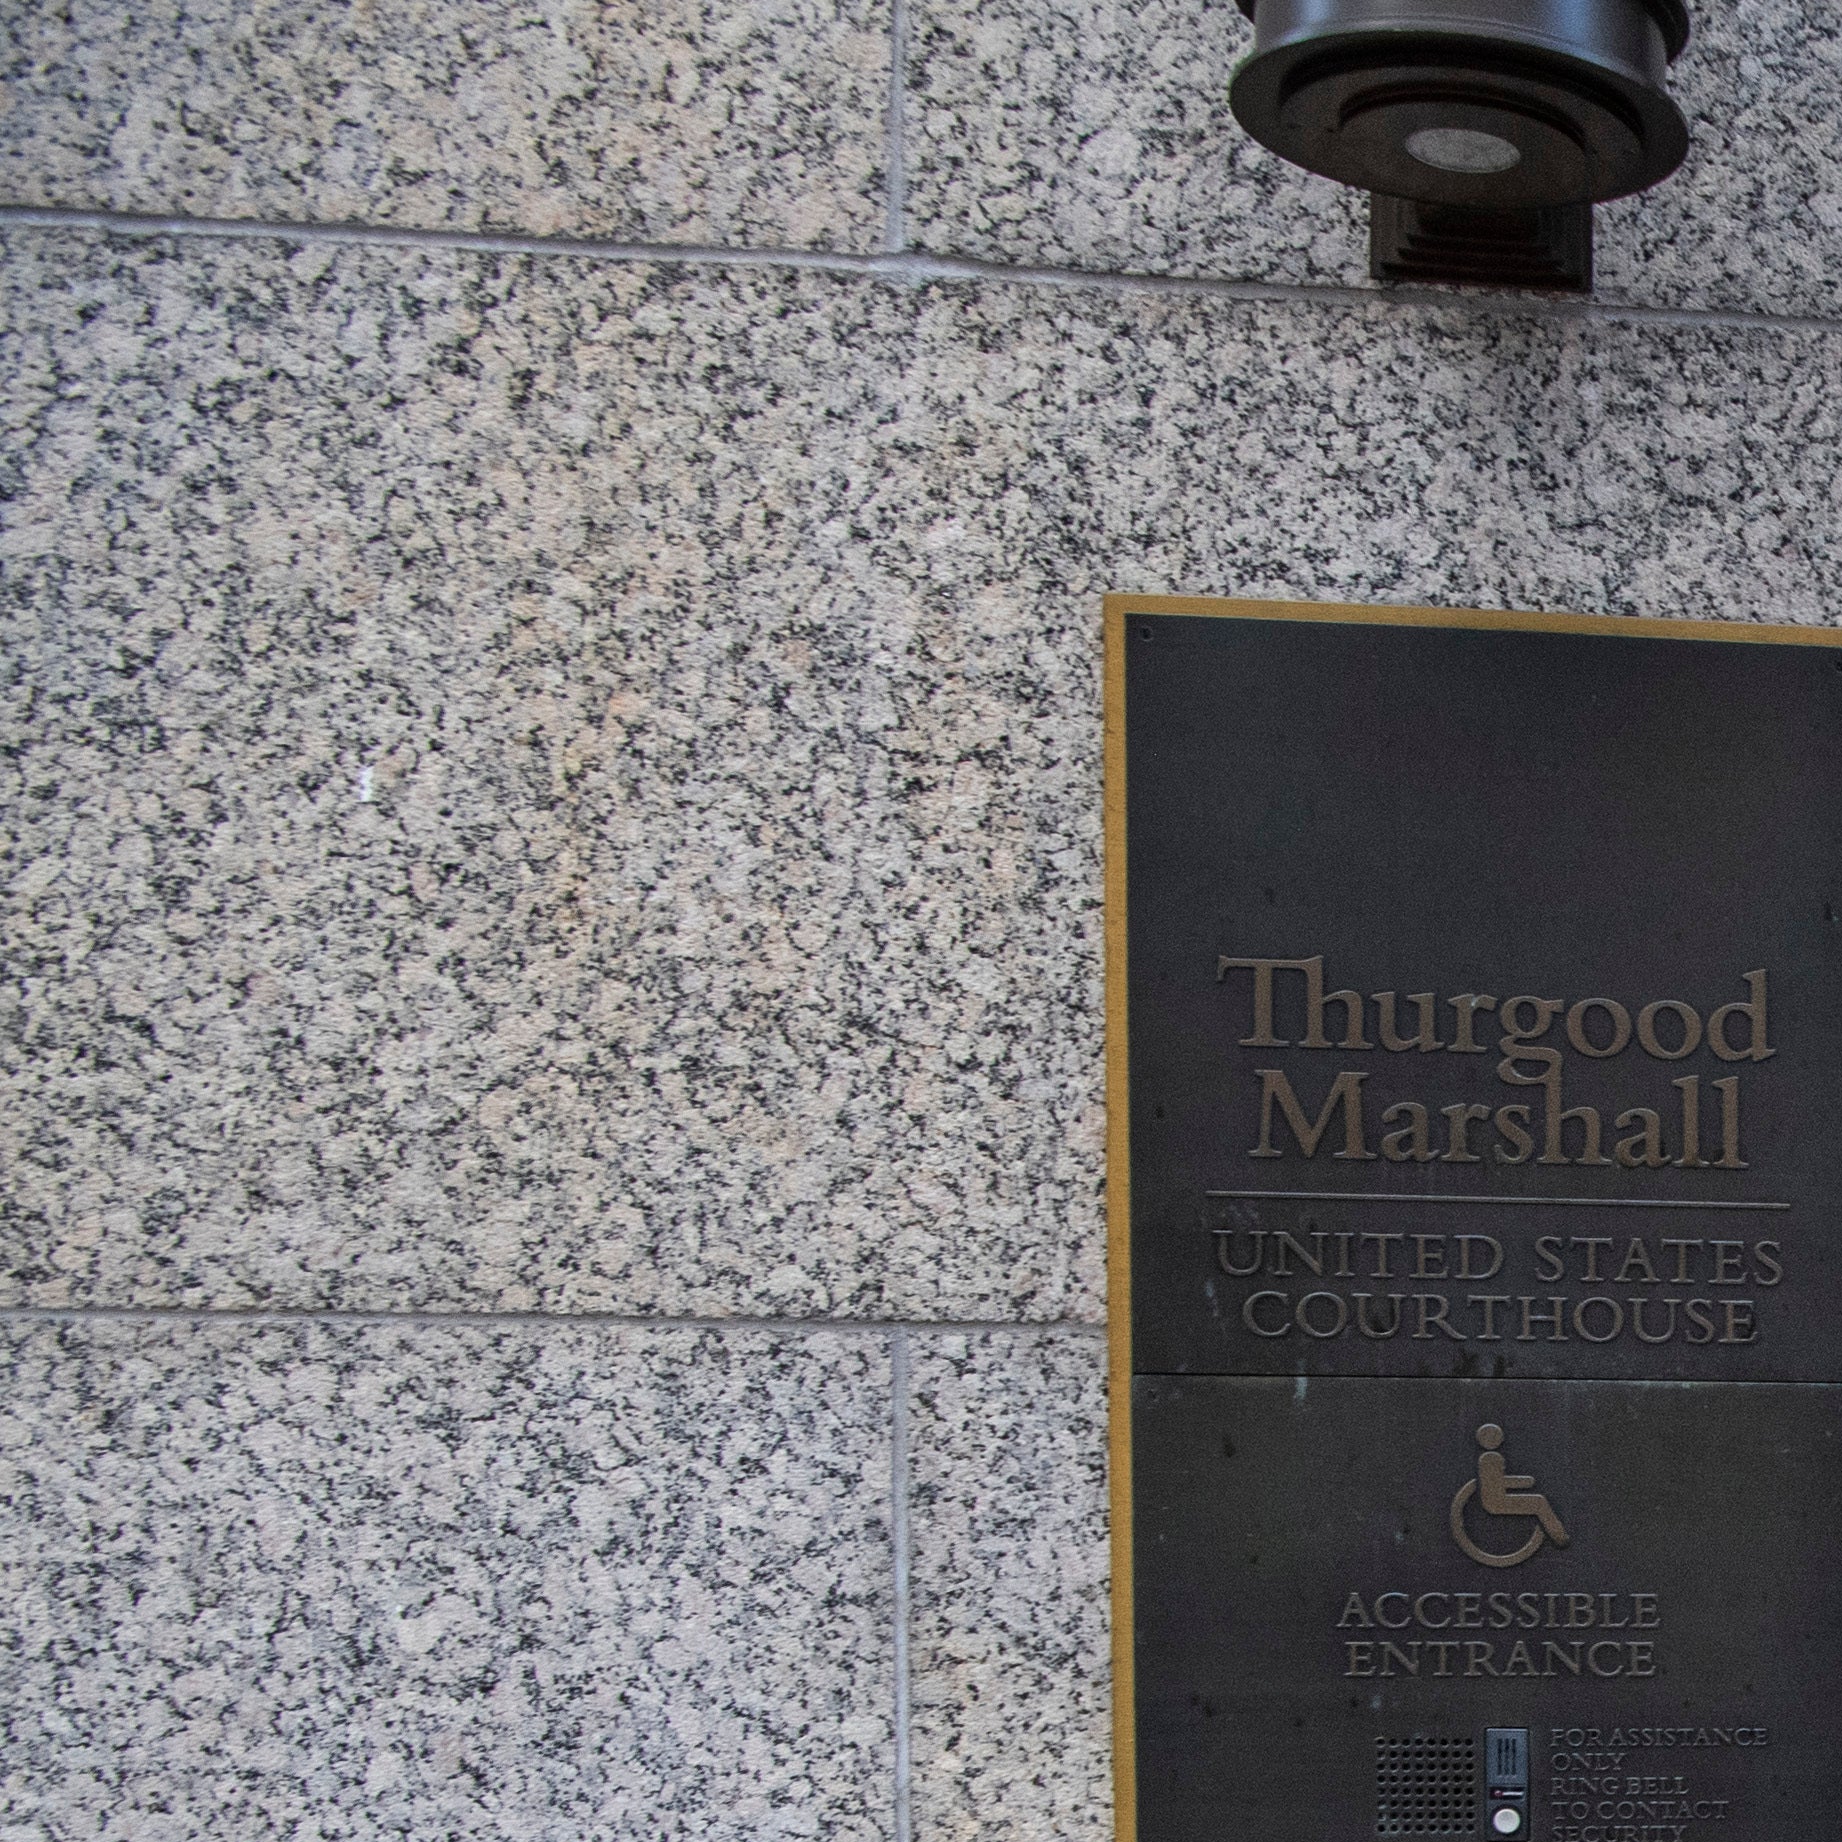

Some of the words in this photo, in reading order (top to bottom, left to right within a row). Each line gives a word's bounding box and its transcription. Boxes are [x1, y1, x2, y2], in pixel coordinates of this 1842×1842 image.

[1216, 954, 1776, 1085] Thurgood
[1248, 1066, 1750, 1169] Marshall
[1212, 1229, 1504, 1280] UNITED
[1533, 1235, 1784, 1286] STATES
[1241, 1290, 1760, 1344] COURTHOUSE
[1336, 1591, 1661, 1629] ACCESSIBLE
[1343, 1640, 1658, 1678] ENTRANCE
[1550, 1728, 1603, 1747] FOR
[1608, 1727, 1768, 1746] ASSISTANCE
[1551, 1752, 1626, 1771] ONLY
[1550, 1777, 1620, 1796] RING
[1625, 1776, 1690, 1795] BELL
[1551, 1801, 1589, 1820] TO
[1598, 1800, 1730, 1820] CONTACT
